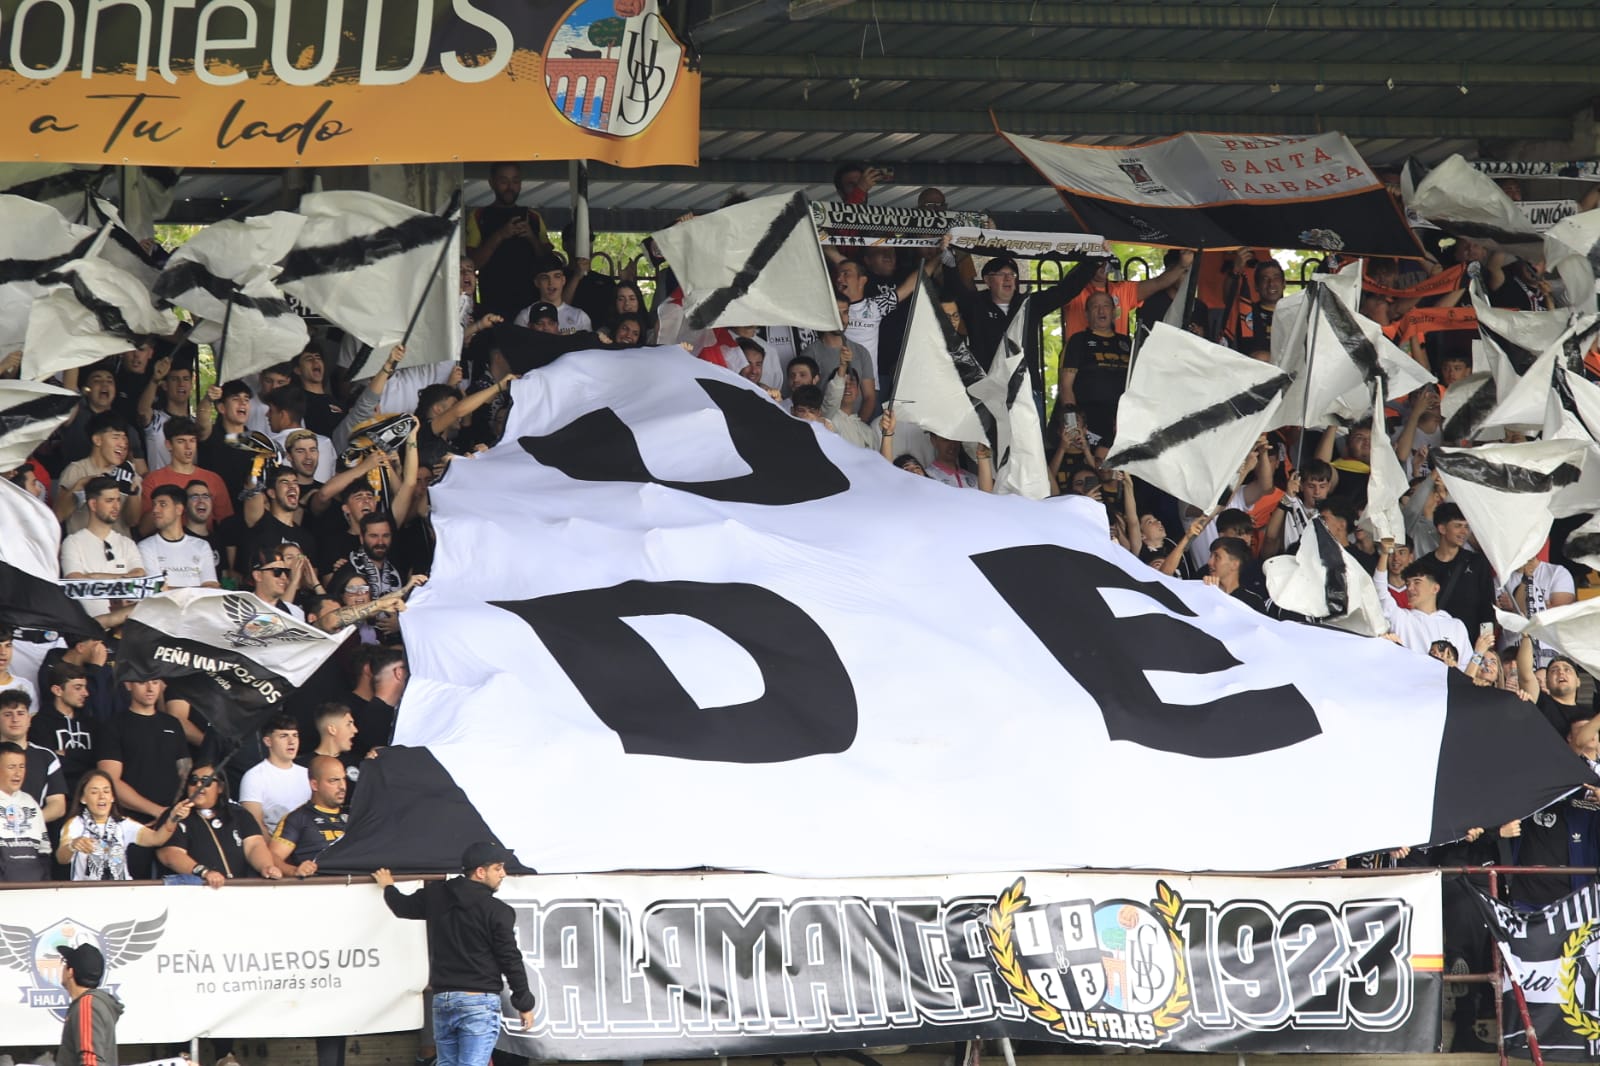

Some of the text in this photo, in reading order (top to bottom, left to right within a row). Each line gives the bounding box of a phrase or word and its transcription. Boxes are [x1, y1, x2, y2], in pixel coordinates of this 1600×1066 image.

[0, 0, 515, 86] onteUDS
[29, 92, 352, 155] a Tu lado
[1221, 147, 1331, 175] SANTA
[956, 236, 1052, 251] SALAMANCA
[154, 646, 191, 667] PEÑA
[486, 544, 1323, 764] D E
[1069, 911, 1084, 942] 9
[157, 948, 381, 974] PEÑA VIAJEROS UDS
[1178, 900, 1413, 1031] 1923
[196, 974, 342, 994] no caminarás sola
[1040, 967, 1098, 999] 2 3
[33, 994, 66, 1006] HALA
[1061, 1010, 1157, 1041] ULTRAS
